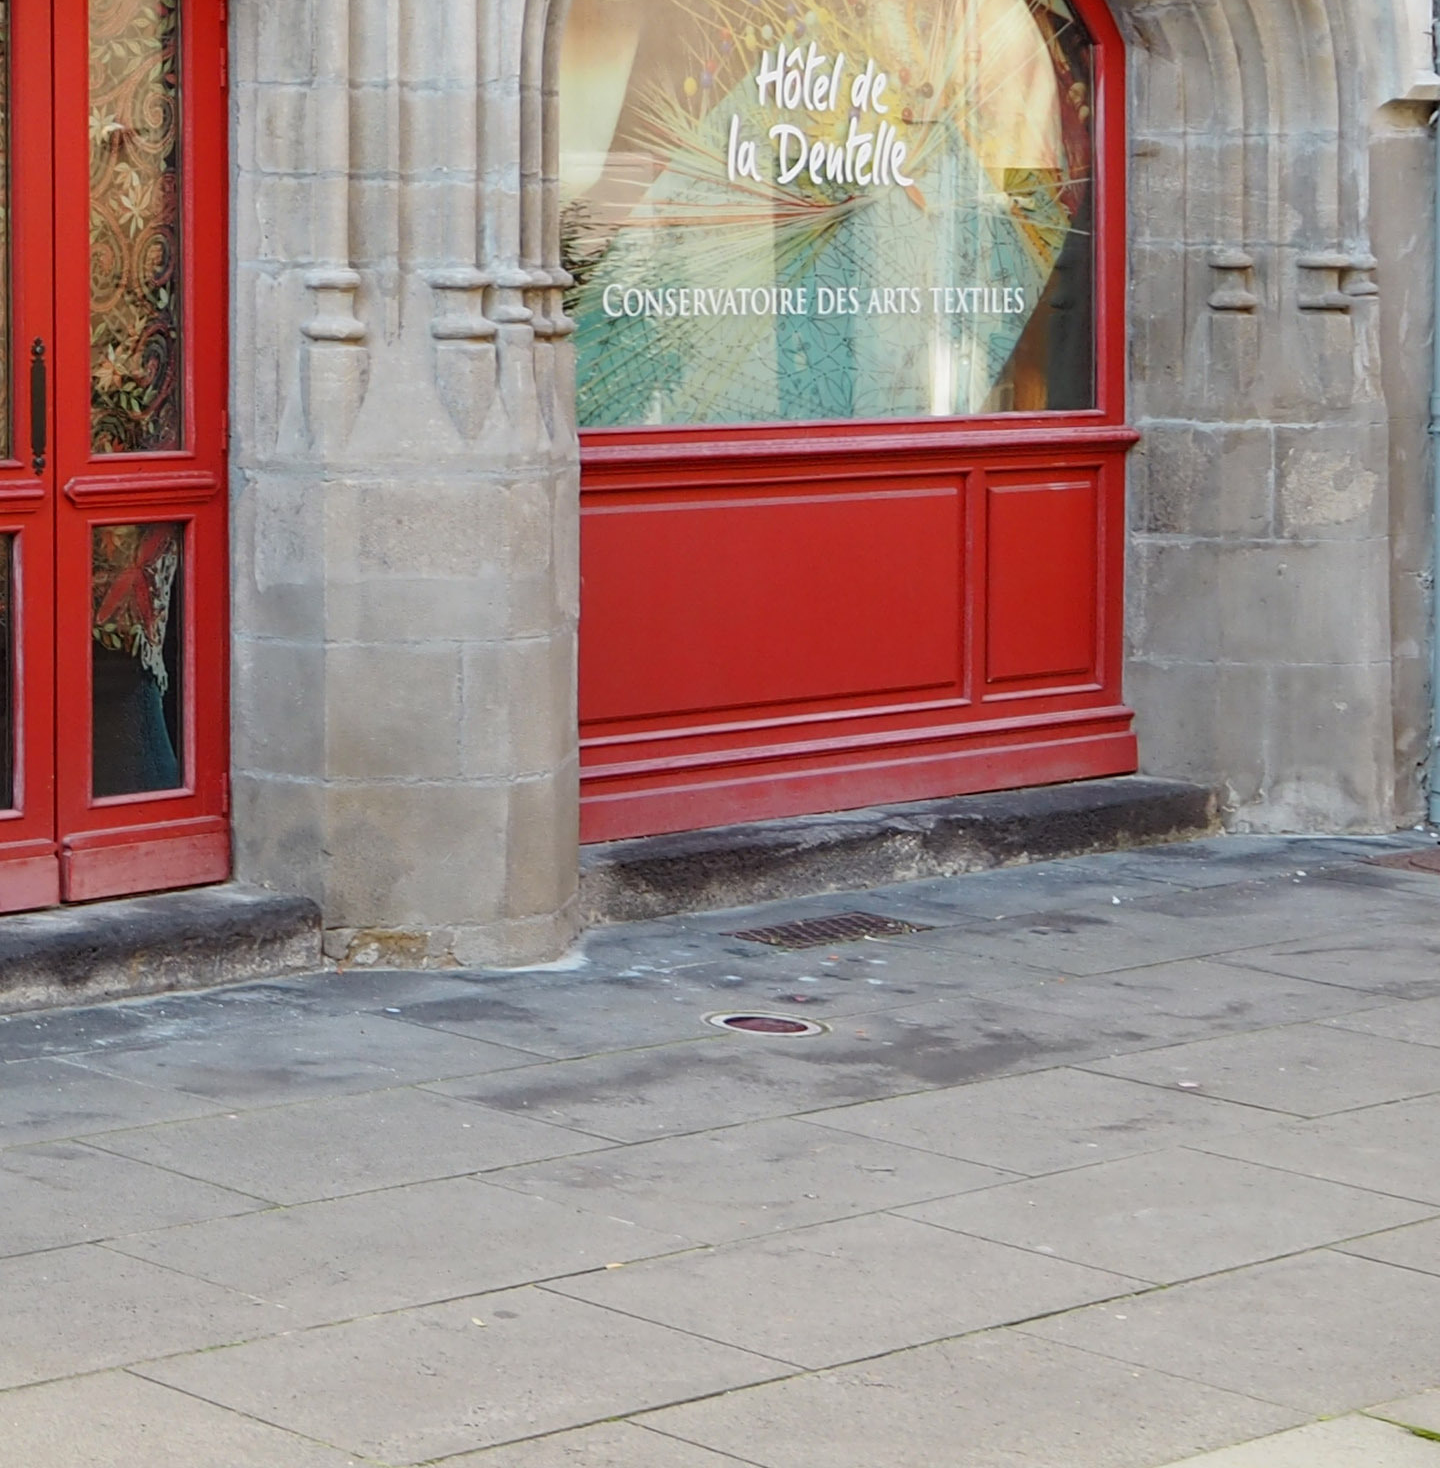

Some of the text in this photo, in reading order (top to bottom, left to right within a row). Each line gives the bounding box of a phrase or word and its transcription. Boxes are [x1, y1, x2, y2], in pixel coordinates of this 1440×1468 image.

[756, 41, 888, 113] Hôtel de
[727, 114, 914, 187] la Dentelle
[602, 283, 1025, 317] CONSERVATOIRE DES ARTS TEXTILES
